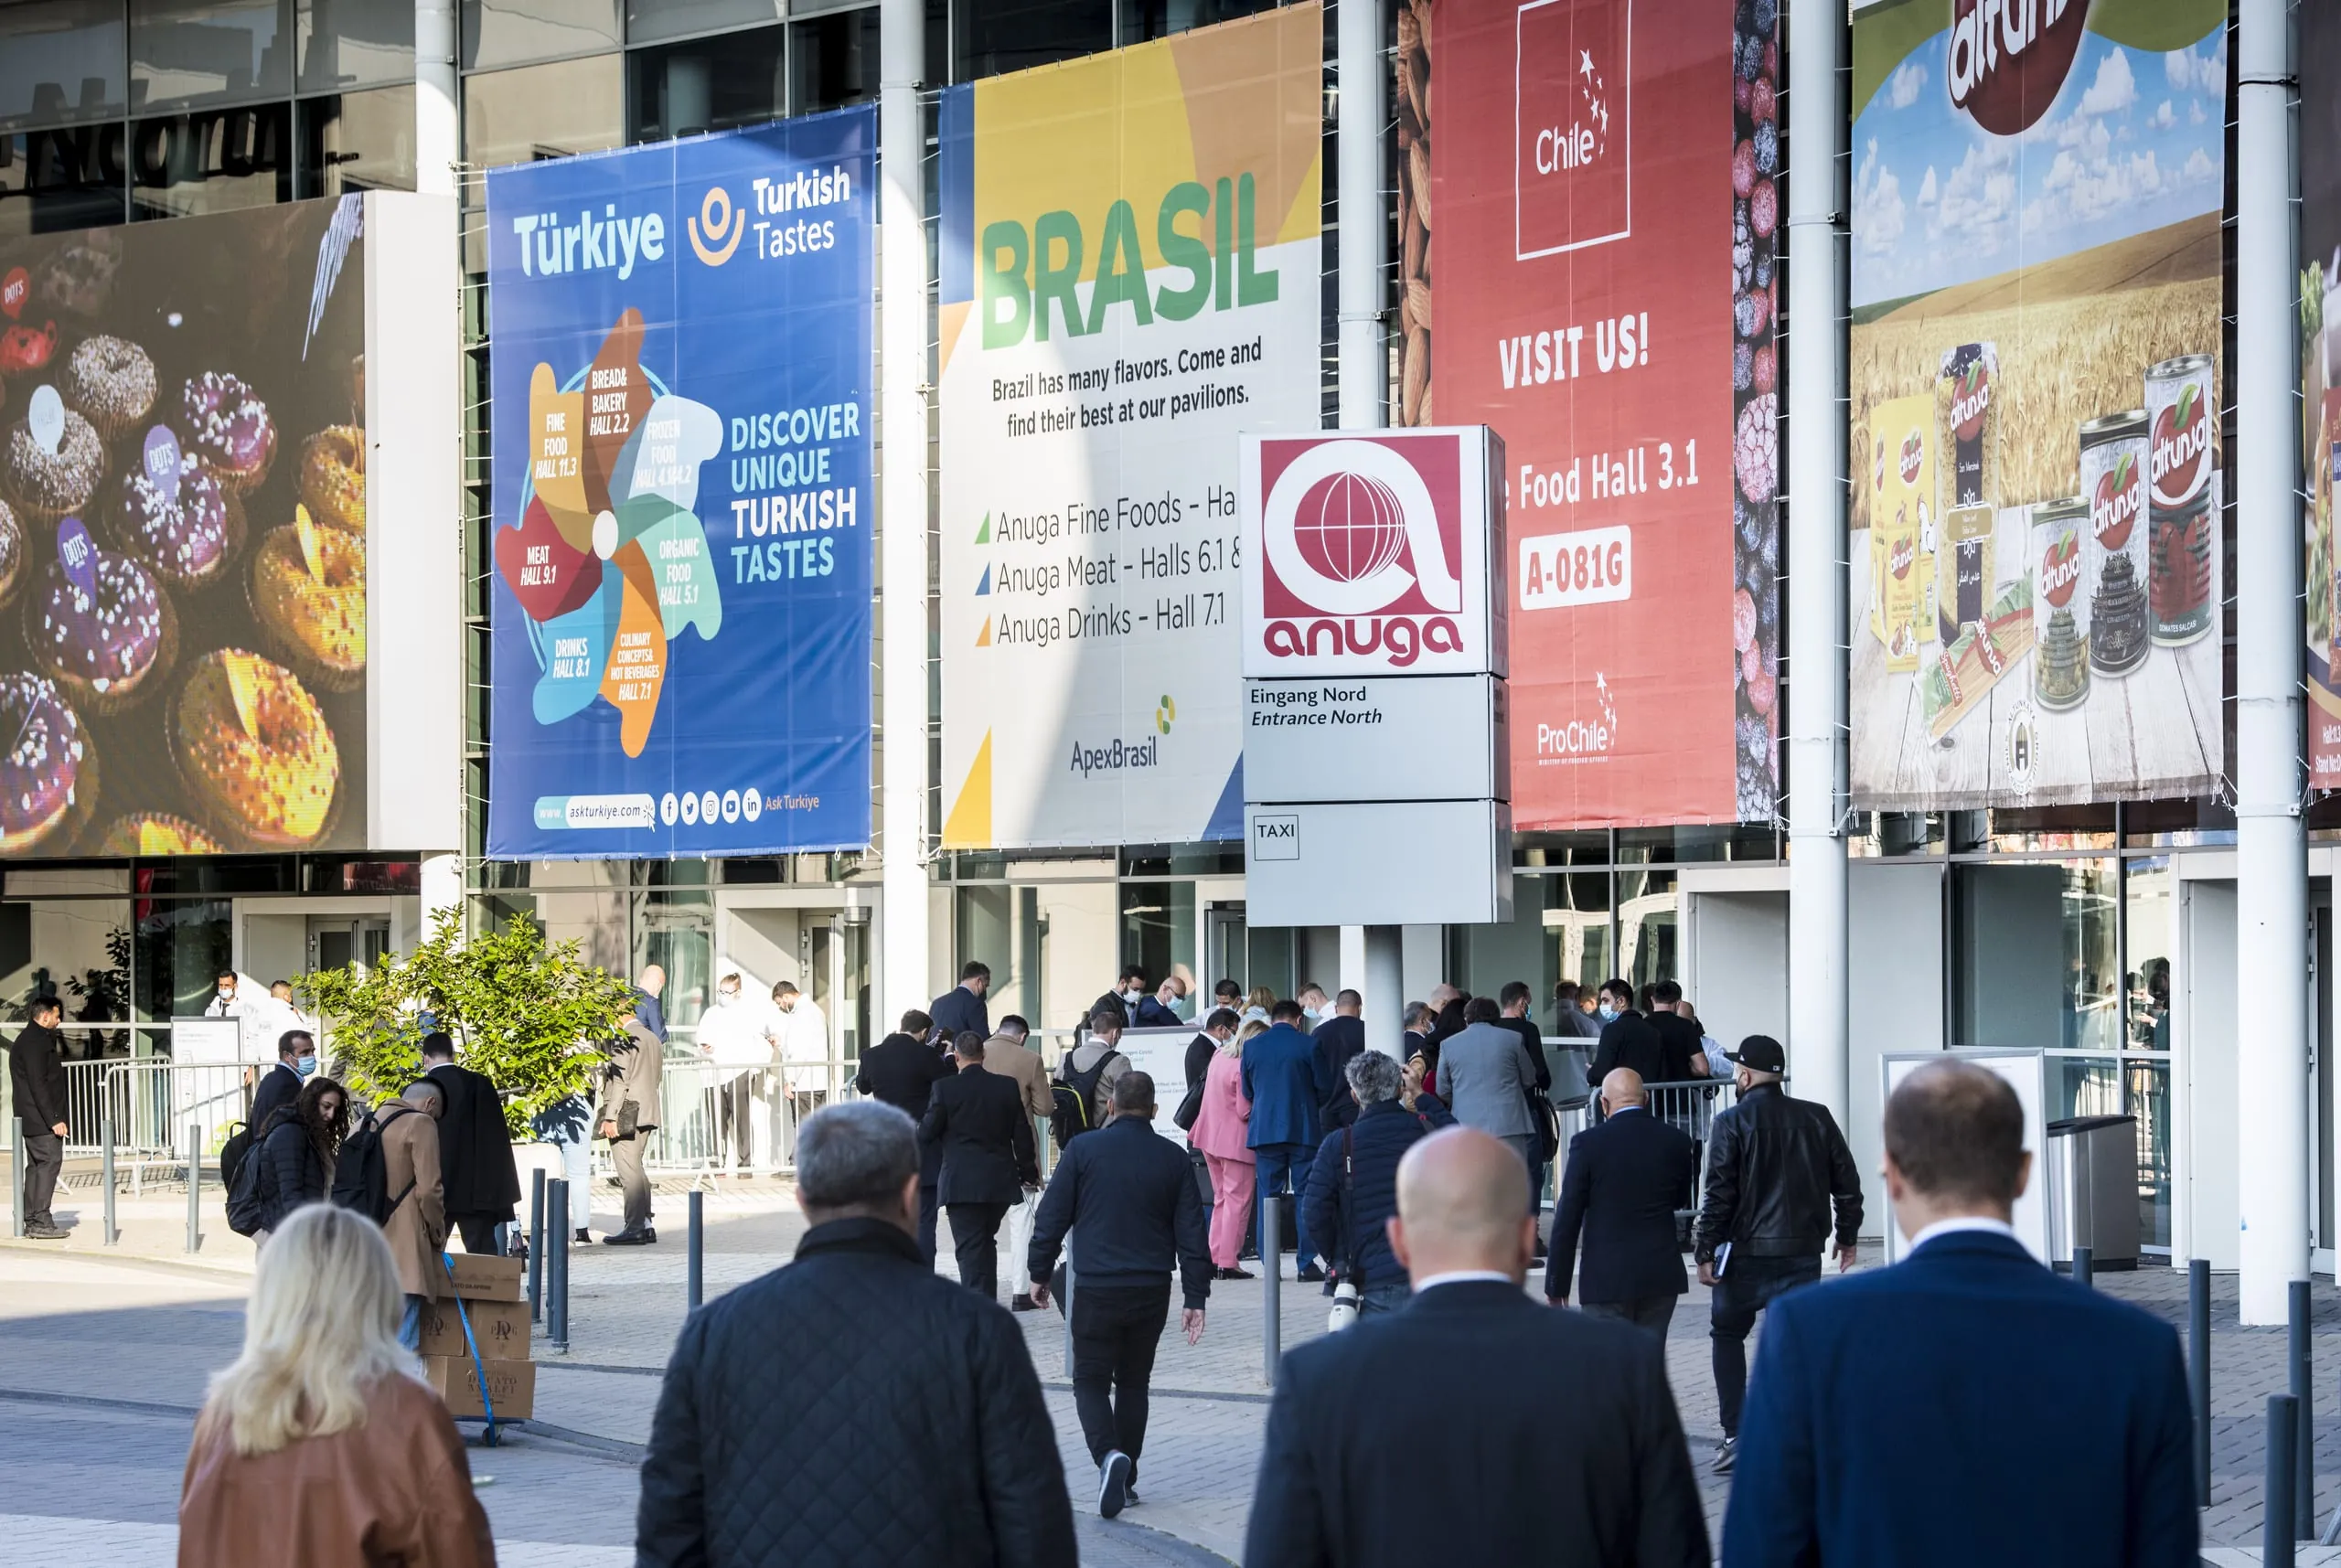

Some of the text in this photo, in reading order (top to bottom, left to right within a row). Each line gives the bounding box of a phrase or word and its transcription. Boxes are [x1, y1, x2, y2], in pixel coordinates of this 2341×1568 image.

[1536, 121, 1594, 175] Chile
[753, 165, 850, 216] Turkish
[514, 204, 665, 281] Türkiye
[753, 219, 835, 261] Tastes
[982, 172, 1279, 350] BRASIL
[5, 280, 24, 297] DOTS
[1499, 312, 1648, 389] VISIT US!
[992, 336, 1262, 402] Brazil has many flavors. Come and
[593, 392, 627, 414] BAKERY
[1008, 383, 1249, 437] find their best at our pavilions.
[1950, 384, 1989, 432] altunsa
[546, 412, 565, 432] FINE
[589, 413, 629, 436] HALL 2.2
[647, 420, 680, 441] FROZEN
[732, 402, 861, 452] DISCOVER
[148, 443, 175, 473] DOTS
[544, 436, 568, 457] FOOD
[651, 444, 676, 465] FOOD
[2151, 416, 2206, 484] altunsa
[535, 456, 577, 480] HALL 11.3
[732, 448, 831, 494] UNIQUE
[1520, 457, 1580, 509] Food
[1592, 447, 1646, 500] Hall
[1658, 439, 1699, 490] 3.1
[732, 487, 857, 539] TURKISH
[997, 512, 1060, 545] Anuga
[1067, 503, 1110, 537] Fine
[1117, 491, 1181, 530] Foods
[2093, 480, 2141, 538] altunsa
[63, 534, 88, 566] DOTS
[527, 545, 551, 566] MEAT
[659, 538, 700, 559] ORGANIC
[732, 536, 834, 584] TASTES
[520, 564, 557, 586] HALL 9.1
[667, 563, 691, 583] FOOD
[998, 563, 1060, 596] Anuga
[1067, 553, 1117, 588] Meat
[1141, 542, 1191, 580] Halls
[1198, 538, 1224, 572] 6.1
[1526, 540, 1623, 596] A-081G
[2040, 552, 2079, 596] altunsa
[659, 583, 699, 607] HALL 5.1
[998, 613, 1060, 647] Anuga
[1067, 603, 1131, 639] Drinks
[1156, 594, 1194, 631] Hall
[1203, 592, 1225, 625] 7.1
[555, 637, 588, 657] DRINKS
[620, 632, 651, 647] CULINARY
[1263, 616, 1463, 667] anuga
[552, 657, 591, 678] HALL 8.1
[610, 664, 659, 680] HOT BEVERAGES
[618, 681, 652, 701] HALL 7.1
[1251, 686, 1366, 708] Eingang Nord
[1252, 708, 1382, 726] Entrance North
[1537, 719, 1609, 754] ProChile
[1071, 736, 1158, 779] ApexBrasil
[570, 805, 640, 821] askturkiye.com
[765, 795, 819, 812] Ask Turkiye
[1257, 824, 1295, 838] TAXI
